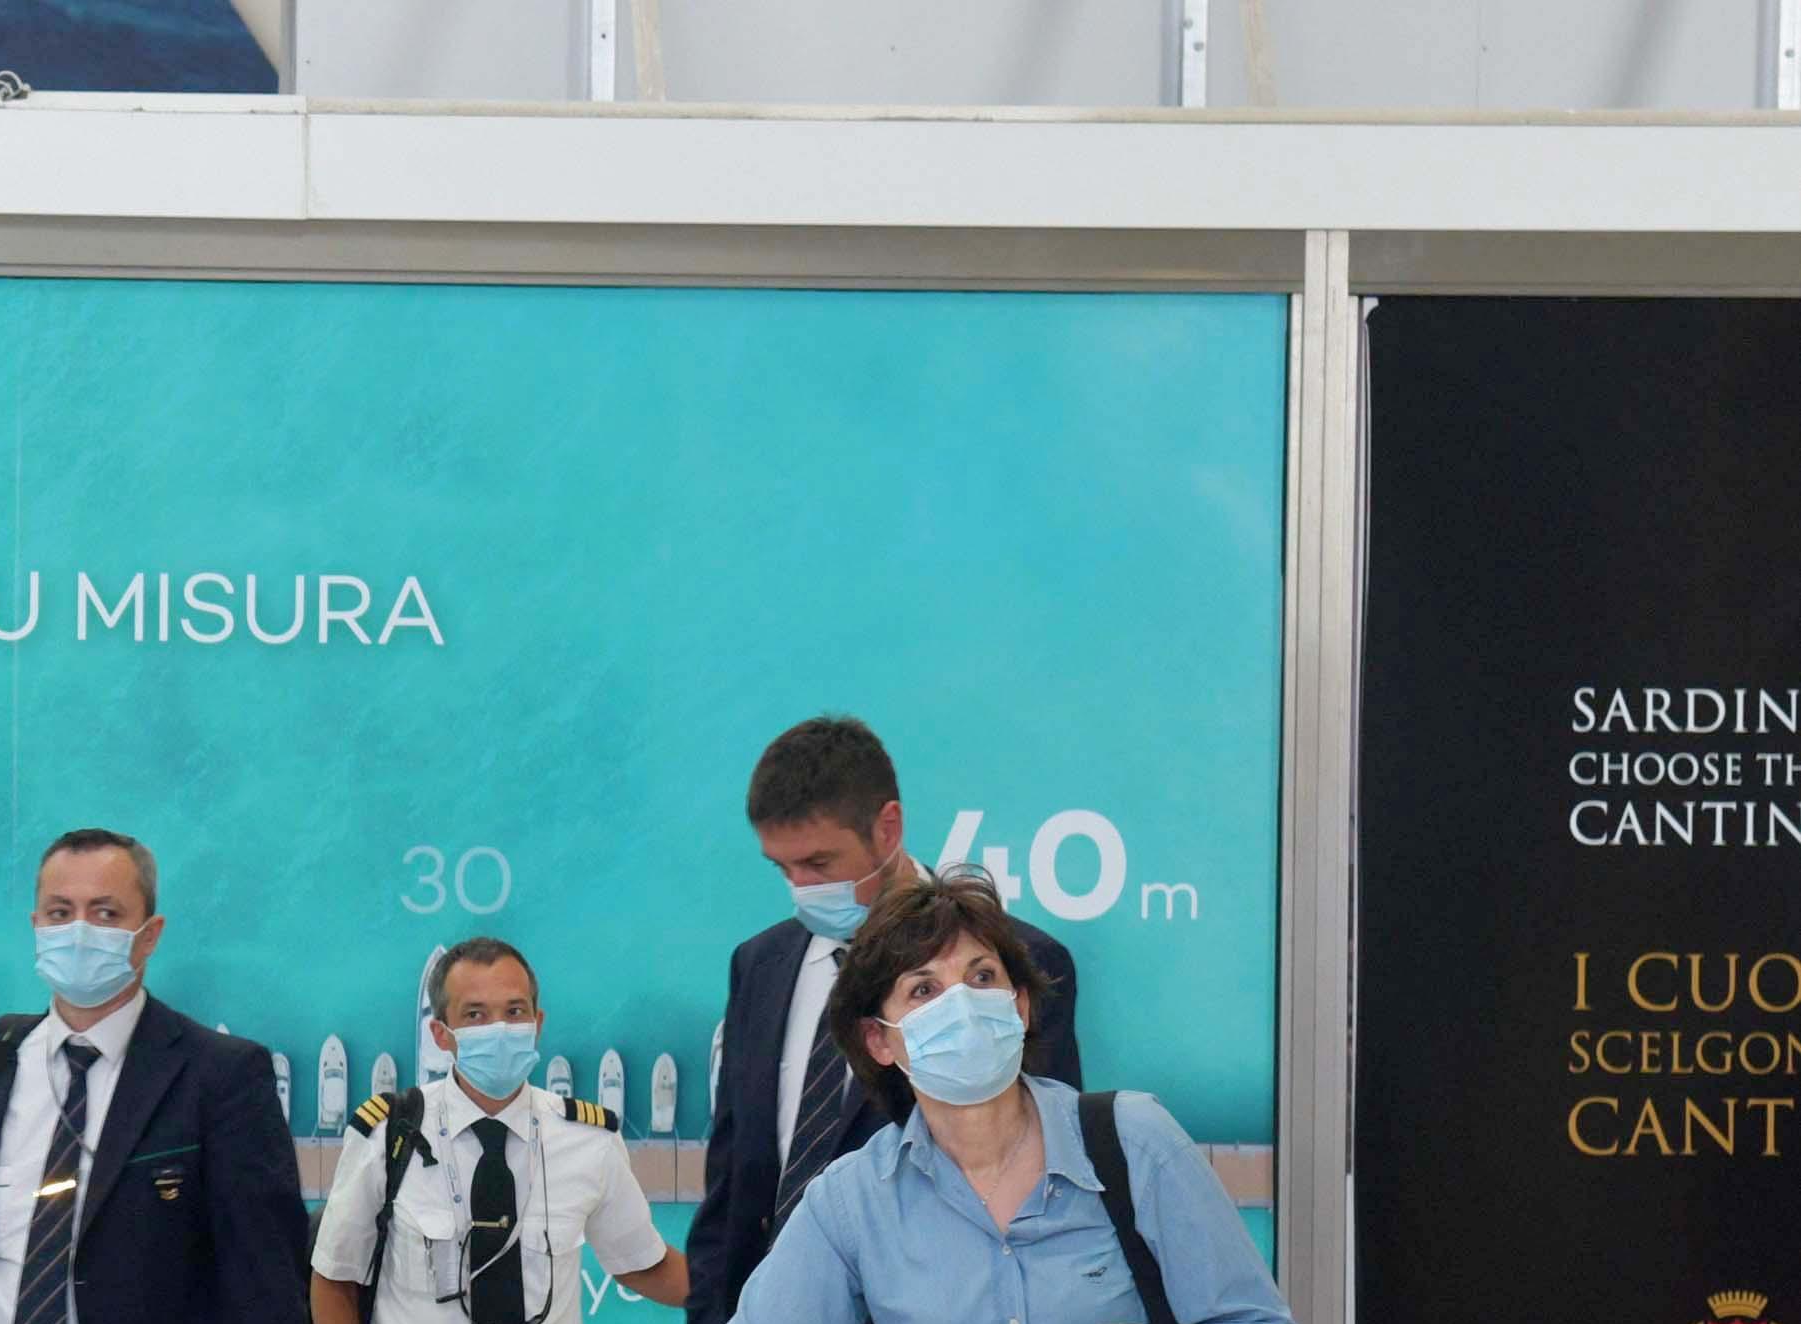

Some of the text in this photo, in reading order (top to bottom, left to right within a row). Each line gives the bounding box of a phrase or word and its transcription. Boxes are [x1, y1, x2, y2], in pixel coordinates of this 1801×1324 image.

[77, 571, 444, 646] MISURA
[1572, 687, 1799, 733] SARDIN
[1569, 752, 1743, 786] CHOOSE
[400, 845, 511, 916] 30
[1140, 882, 1198, 921] m
[1572, 952, 1801, 1014] I CUO
[1568, 1096, 1795, 1157] CANT
